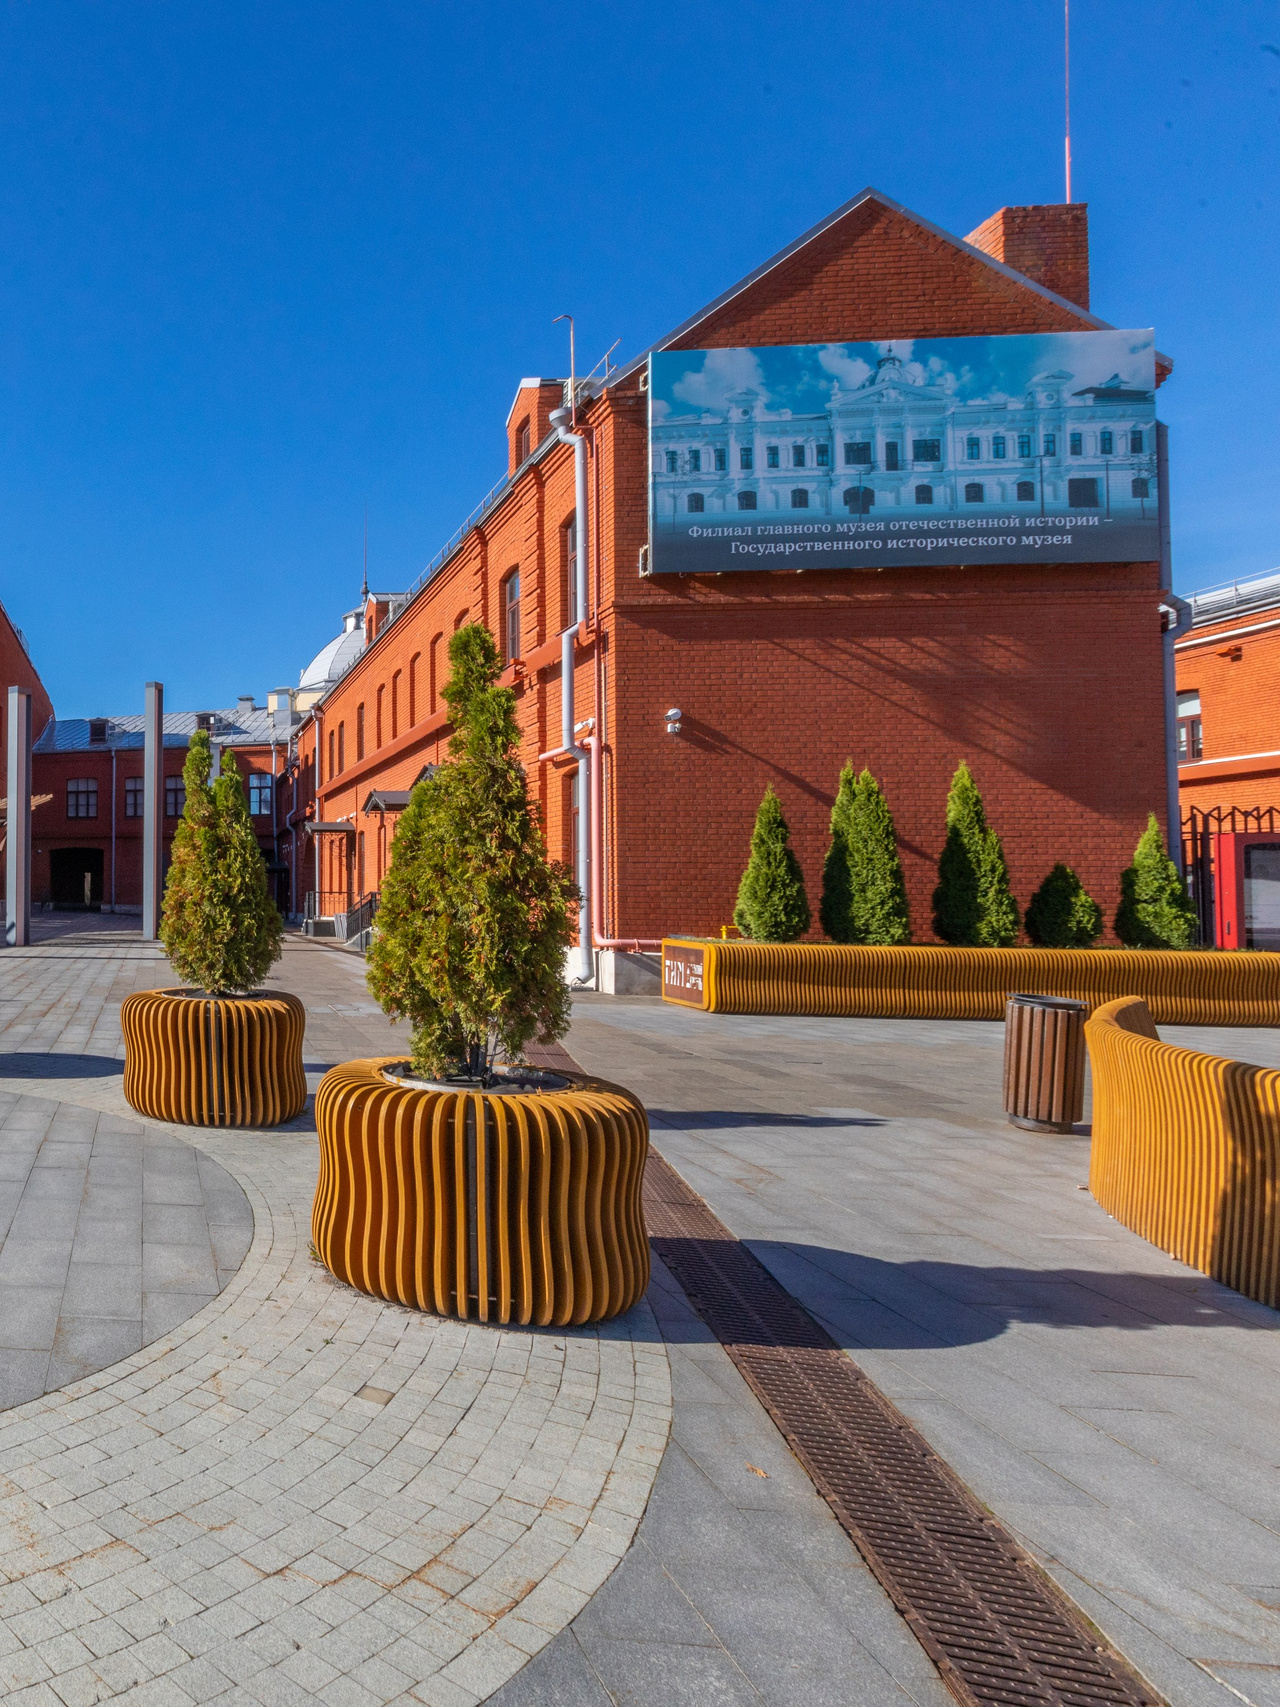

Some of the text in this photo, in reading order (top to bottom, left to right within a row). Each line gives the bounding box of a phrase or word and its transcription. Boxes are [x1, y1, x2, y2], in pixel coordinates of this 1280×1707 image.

[688, 525, 752, 538] Филиал
[756, 523, 831, 536] главного
[835, 522, 885, 535] музея
[889, 515, 1020, 531] отечественной
[1025, 515, 1099, 530] истории
[730, 534, 1073, 555] Государственного исторического музея
